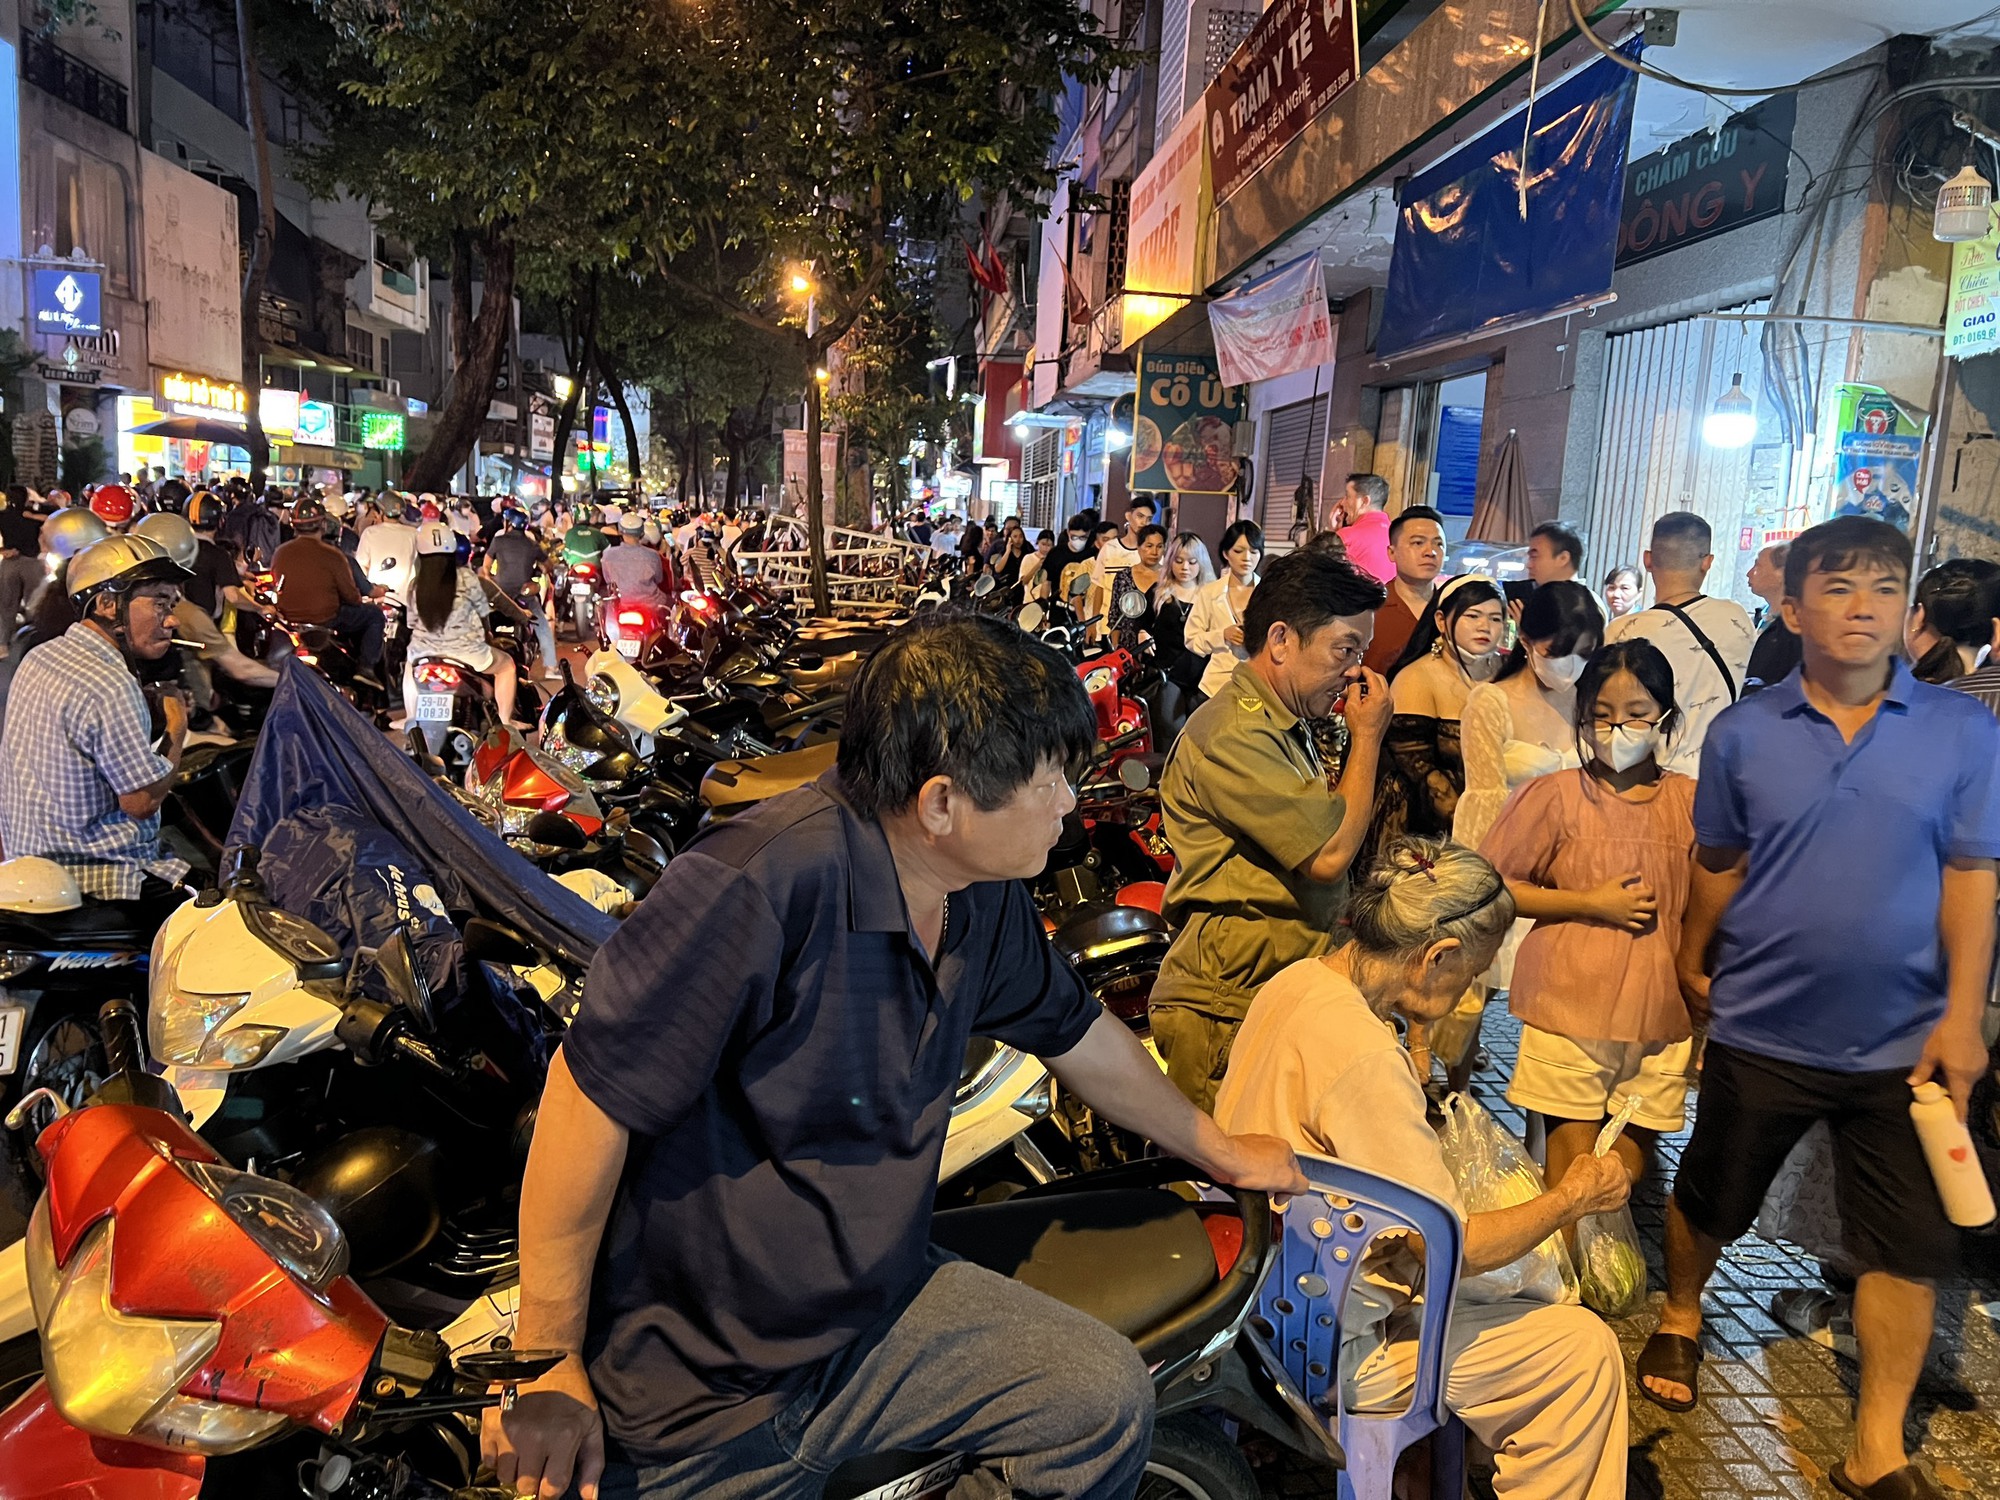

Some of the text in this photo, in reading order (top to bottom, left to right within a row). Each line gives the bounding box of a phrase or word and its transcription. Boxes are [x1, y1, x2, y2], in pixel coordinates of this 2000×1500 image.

[1229, 65, 1271, 135] TRẠM
[1272, 47, 1284, 87] Y
[1288, 0, 1313, 70] TẾ
[1267, 103, 1285, 135] BẾN
[1286, 74, 1312, 117] NGHÉ
[1741, 161, 1769, 213] Y
[1963, 312, 1996, 328] GIAO
[1967, 330, 1987, 343] 0169
[1146, 360, 1206, 375] Bún Riêu
[1150, 375, 1190, 407] Cô
